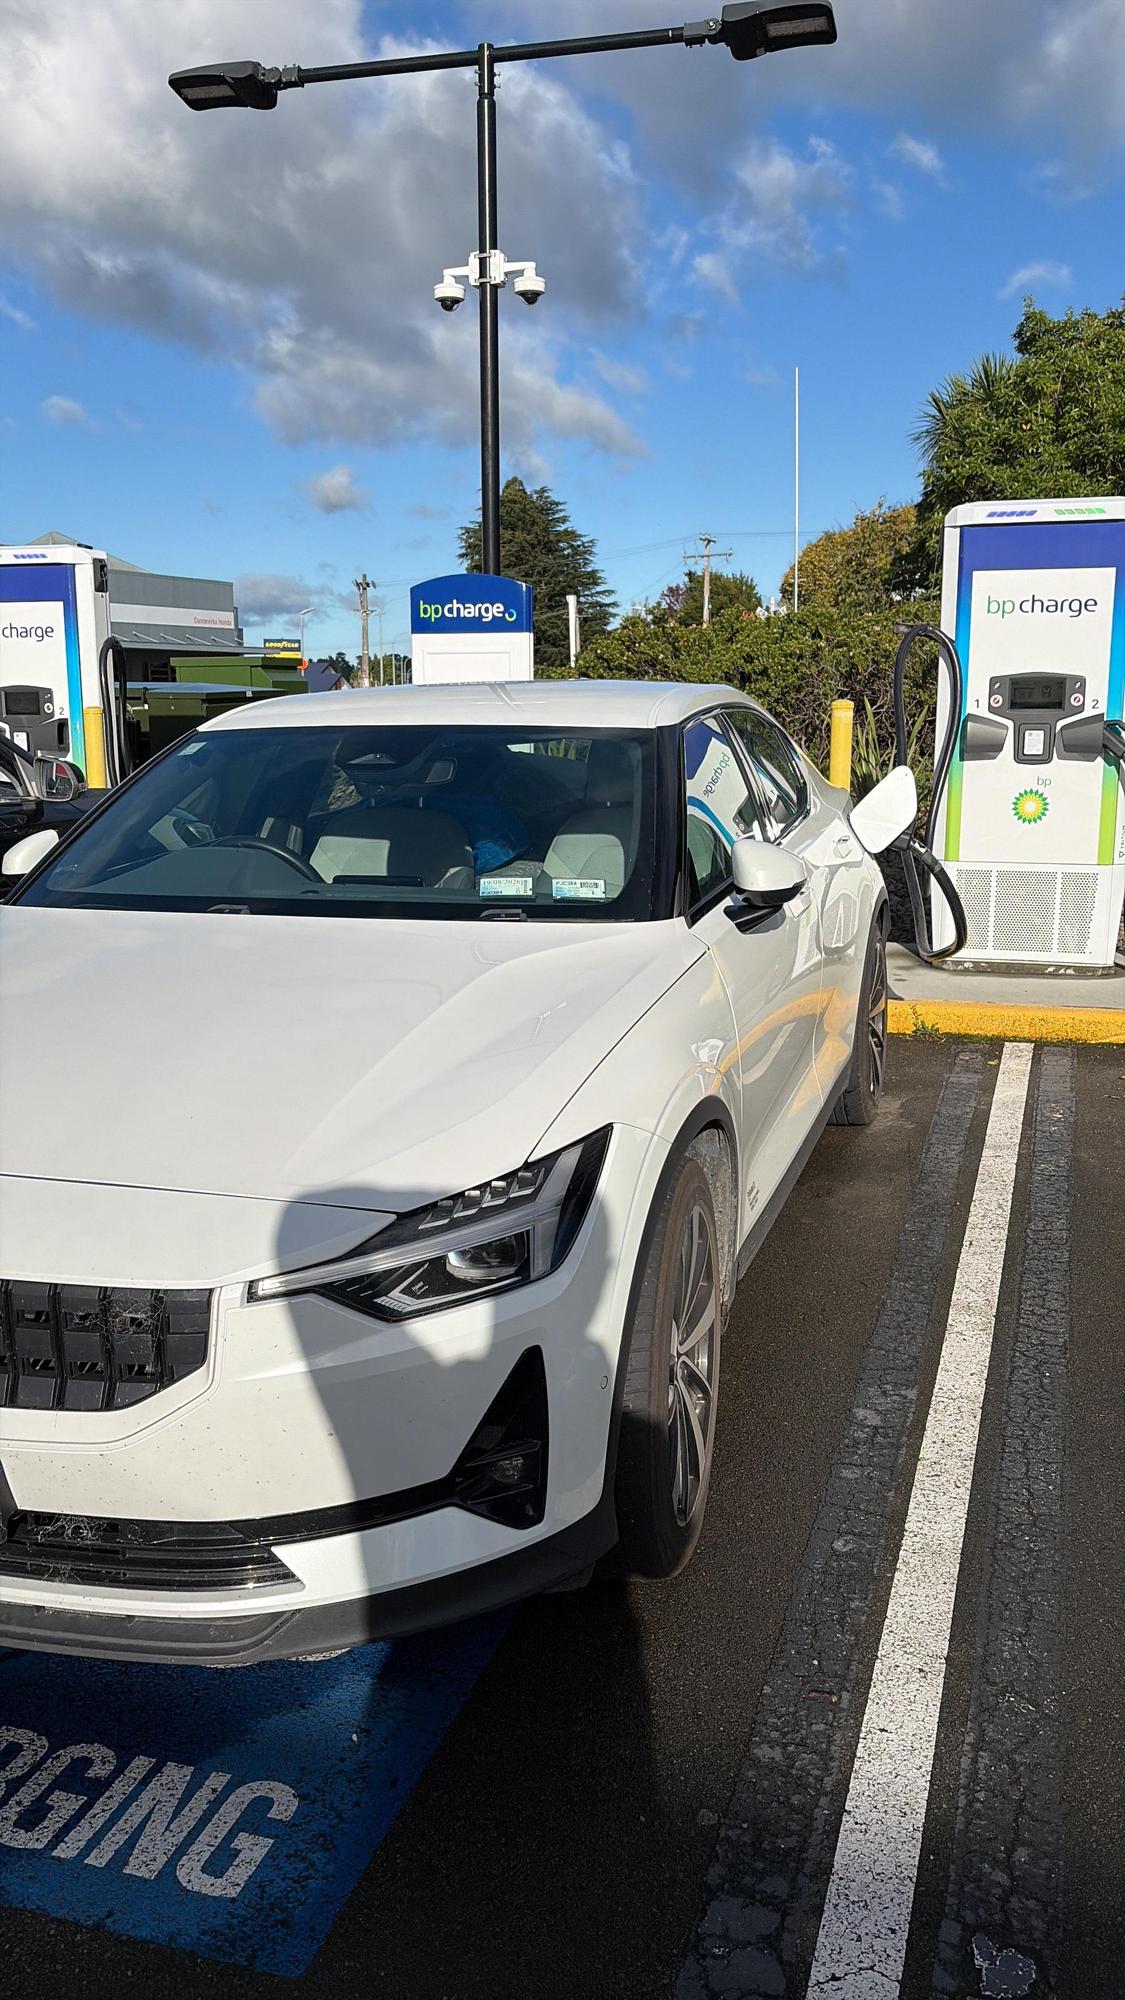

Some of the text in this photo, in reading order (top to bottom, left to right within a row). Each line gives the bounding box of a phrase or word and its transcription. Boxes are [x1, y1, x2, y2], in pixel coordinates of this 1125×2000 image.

[420, 599, 505, 622] bp charge
[987, 594, 1098, 619] bp charge
[2, 622, 54, 642] charge
[974, 699, 980, 709] 1
[1091, 699, 1100, 710] 2
[59, 707, 65, 716] 2
[1036, 775, 1052, 788] bp
